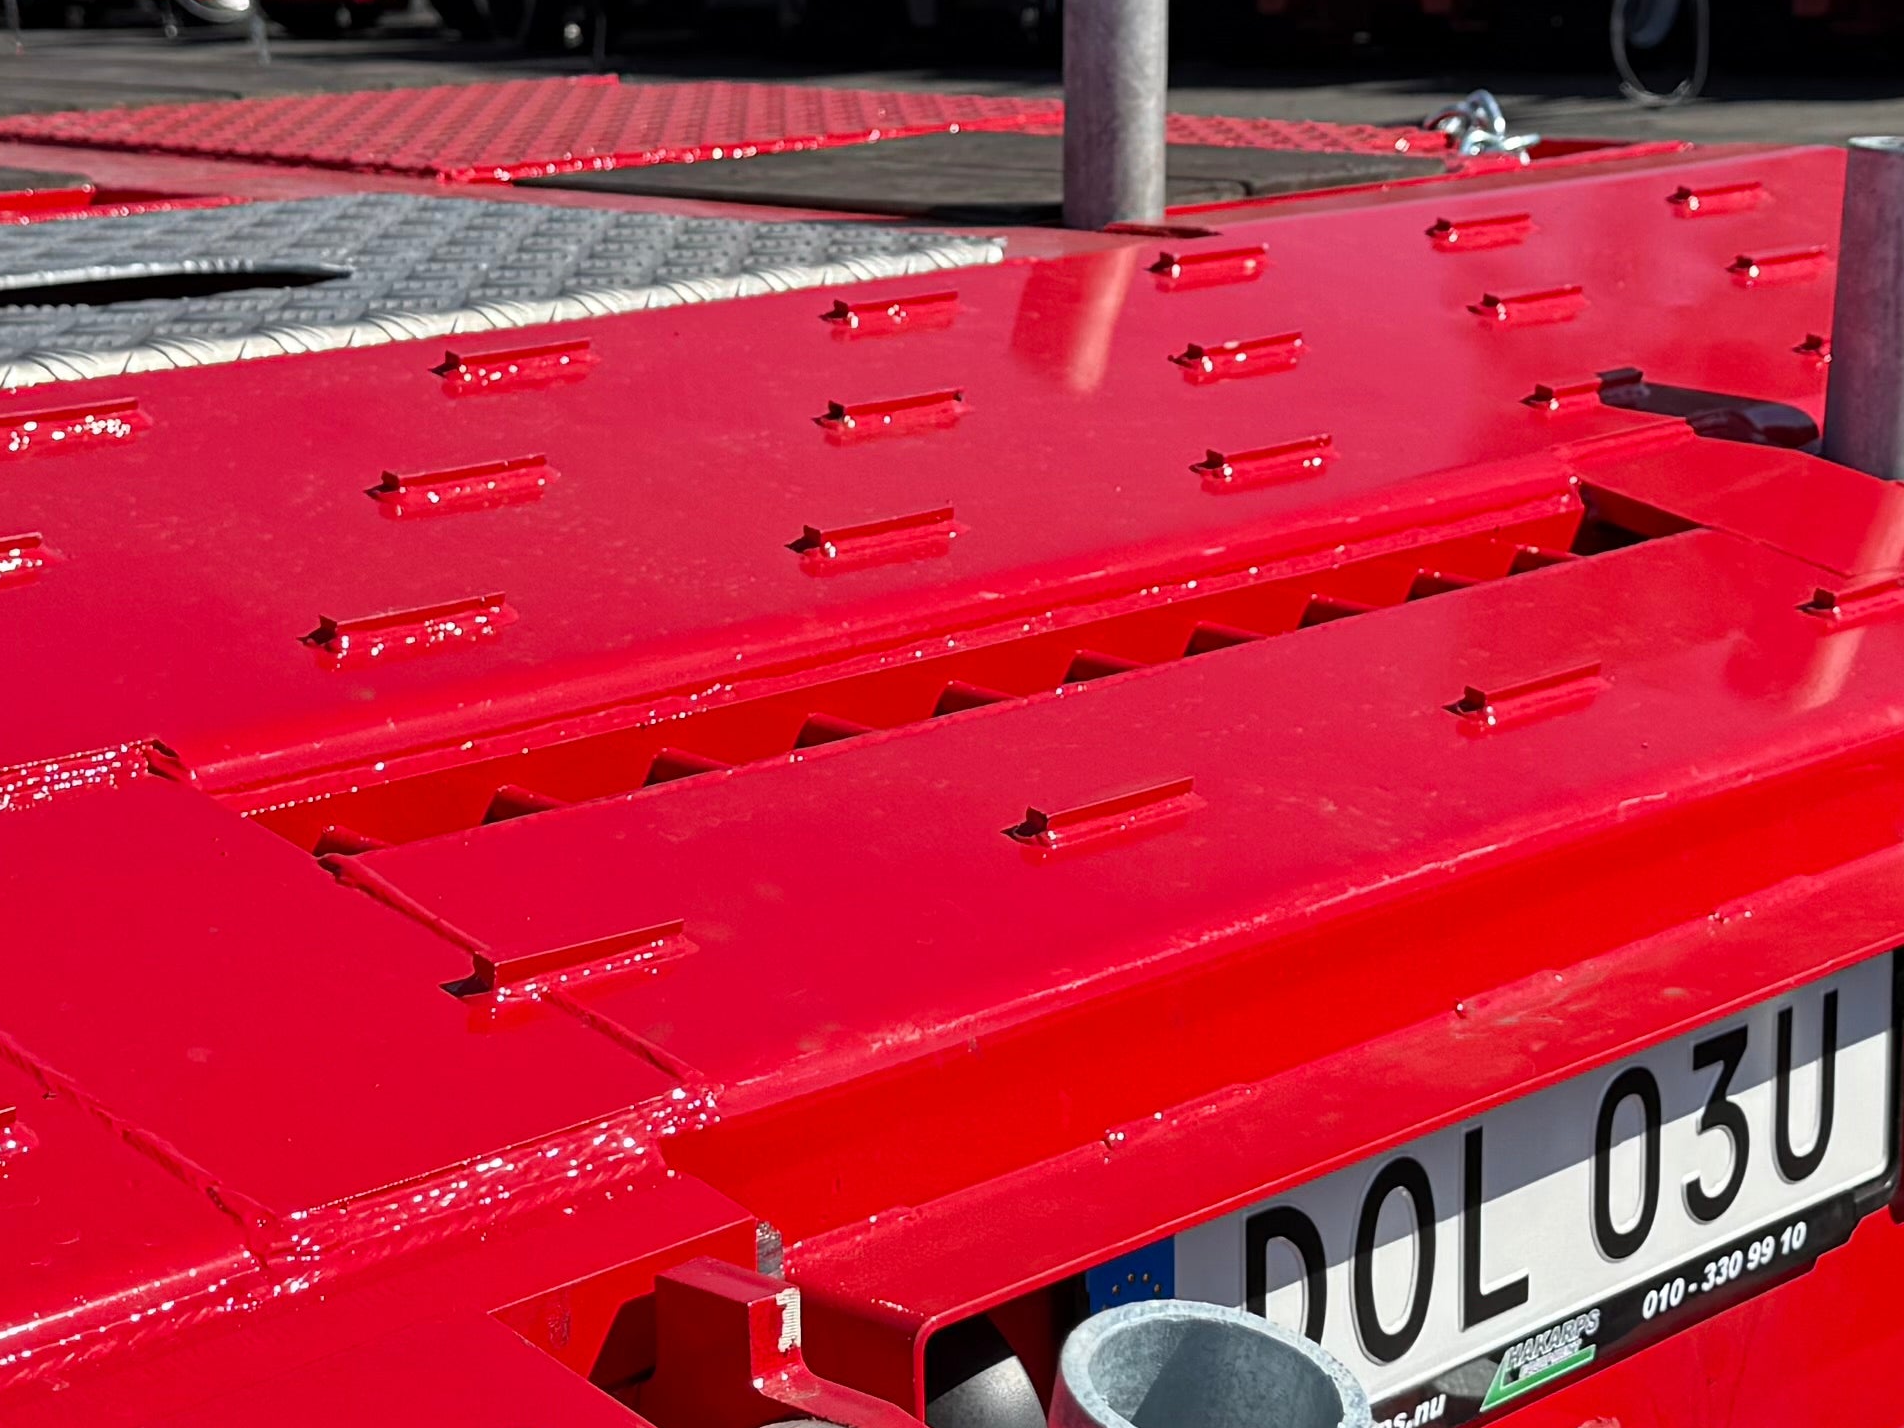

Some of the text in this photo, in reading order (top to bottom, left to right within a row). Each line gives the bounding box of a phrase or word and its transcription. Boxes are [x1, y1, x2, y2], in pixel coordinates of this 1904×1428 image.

[1243, 989, 1839, 1366] DOL 03U
[1642, 1277, 1685, 1320] 010
[1701, 1250, 1744, 1292] 330
[1747, 1235, 1776, 1271] 99
[1780, 1221, 1807, 1255] 10
[1507, 1308, 1601, 1371] HAKARPS
